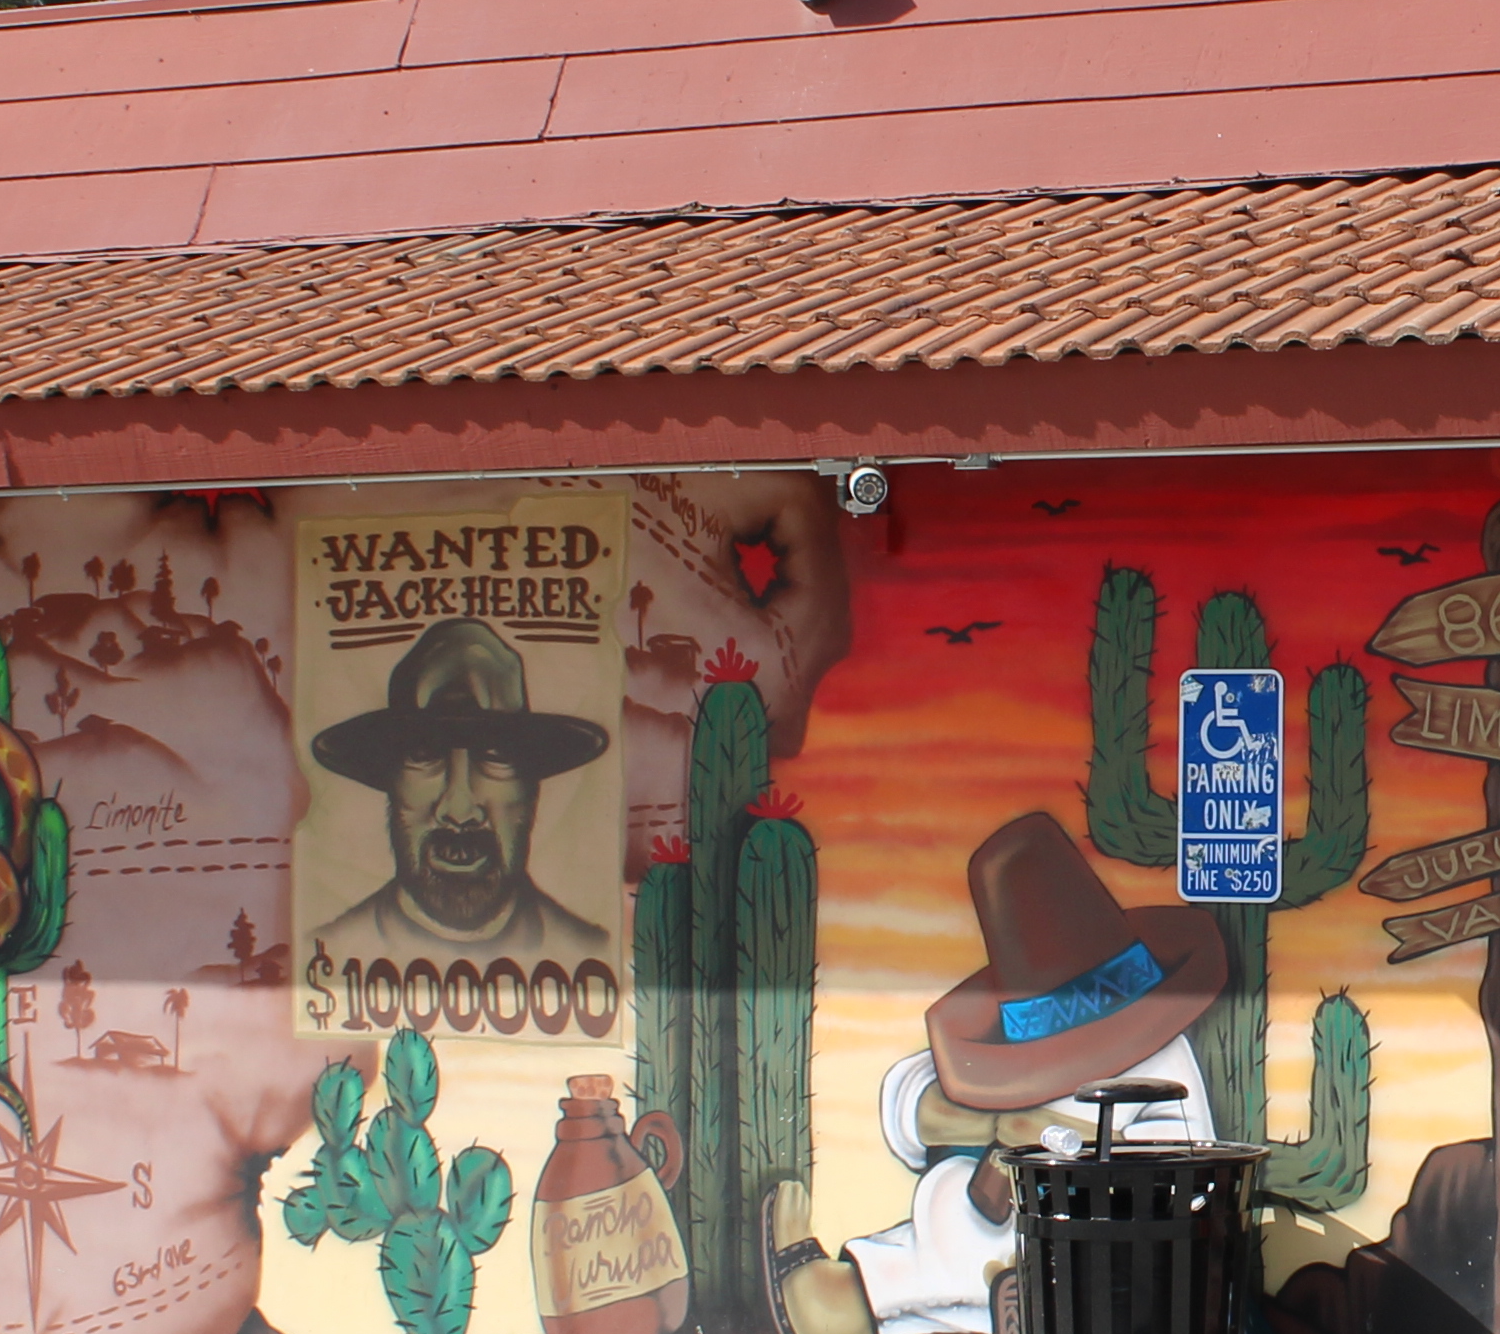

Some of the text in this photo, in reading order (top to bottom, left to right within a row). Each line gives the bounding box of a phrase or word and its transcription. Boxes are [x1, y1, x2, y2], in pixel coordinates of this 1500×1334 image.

[321, 525, 599, 572] WANTED
[326, 575, 601, 622] JACK HERER
[85, 789, 188, 835] Limonite
[1197, 844, 1261, 865] INIMUM
[1187, 869, 1272, 893] FINE $250
[11, 985, 38, 1024] E
[132, 1161, 153, 1209] S
[543, 1191, 653, 1257] Rancho
[113, 1247, 161, 1297] 63rd
